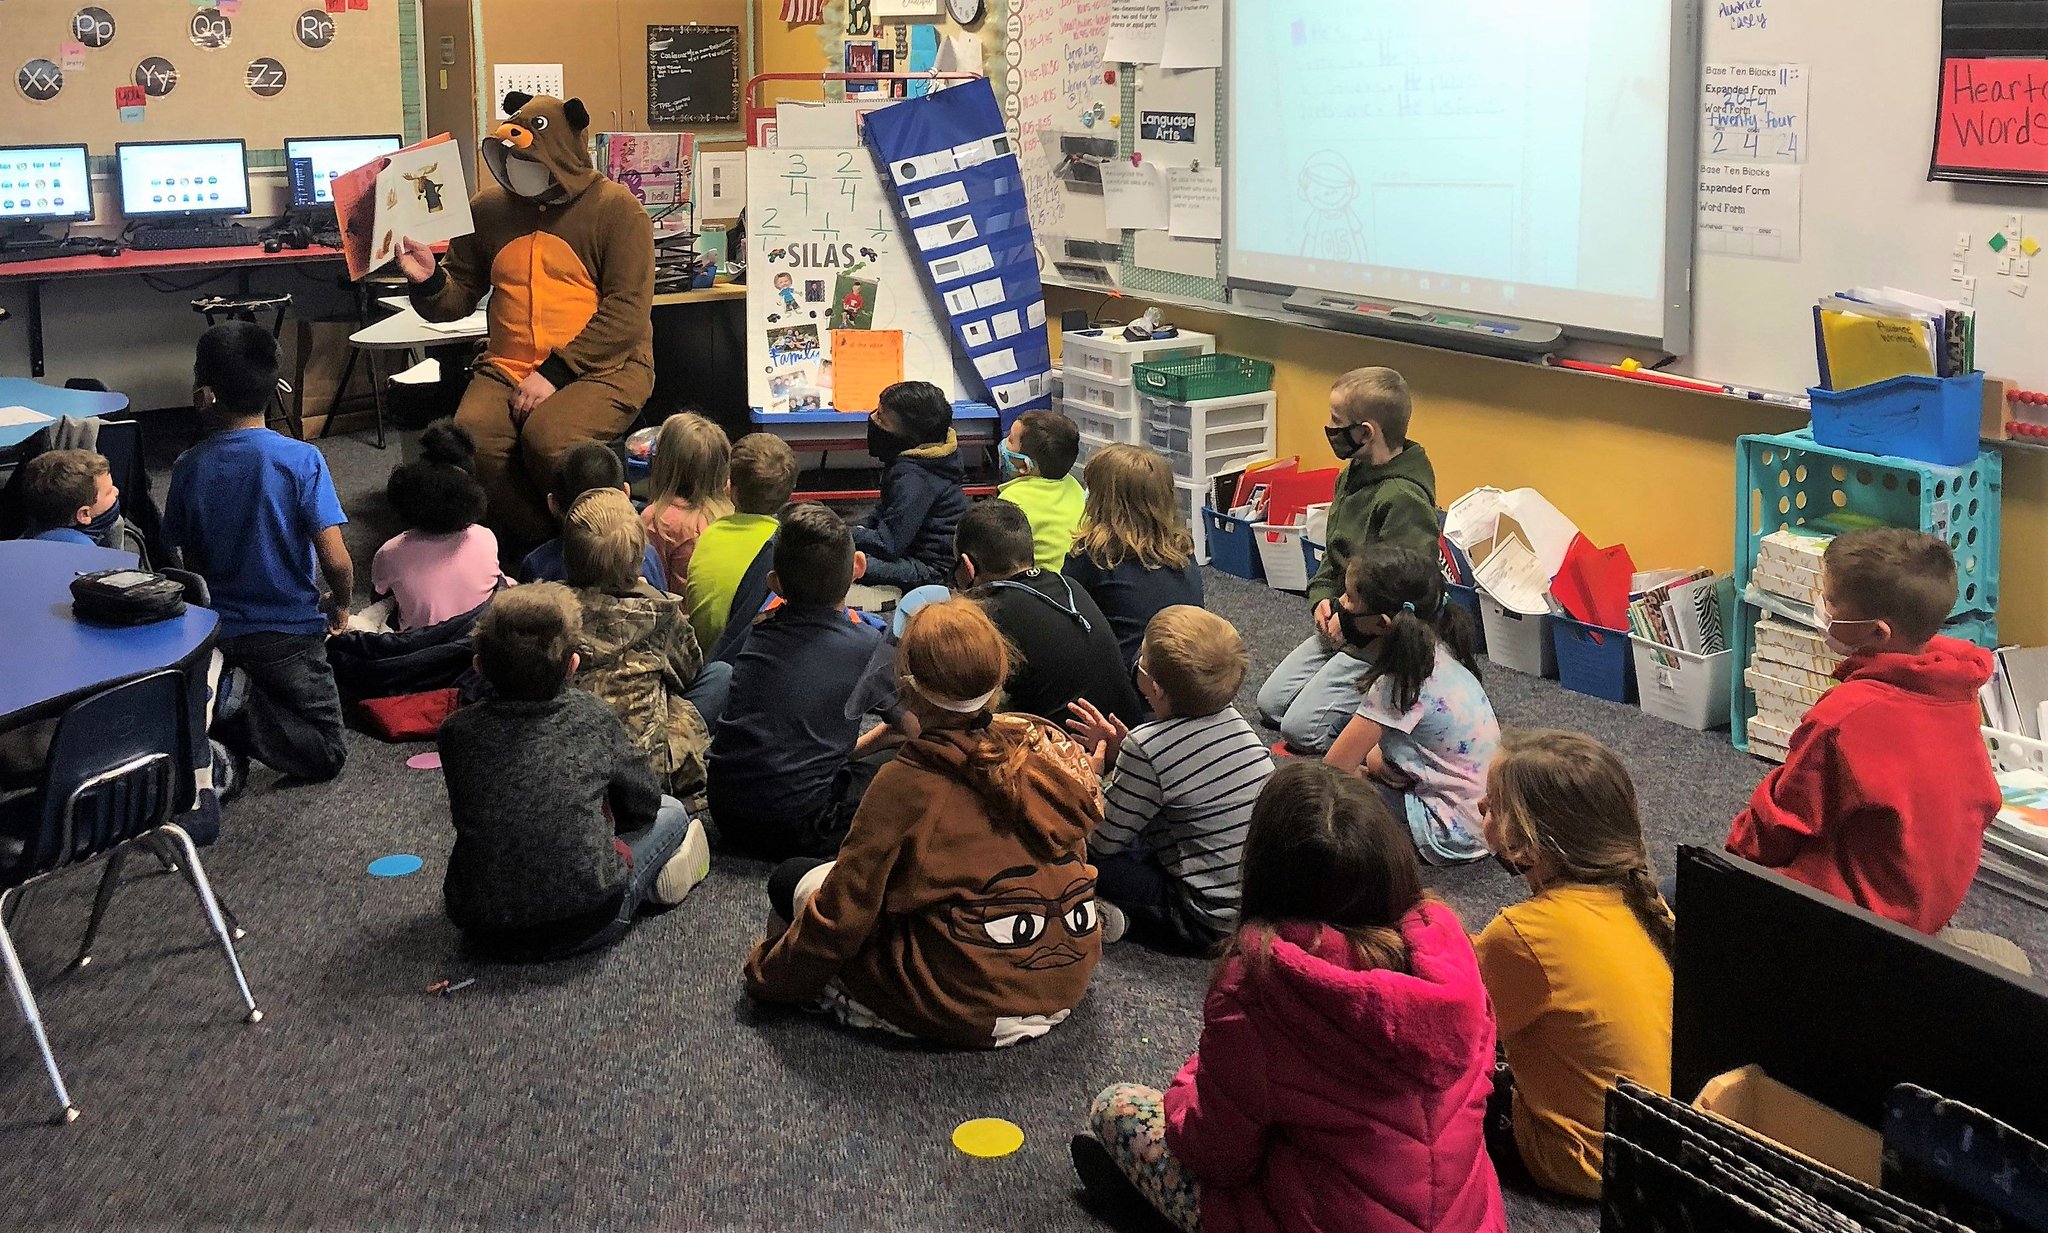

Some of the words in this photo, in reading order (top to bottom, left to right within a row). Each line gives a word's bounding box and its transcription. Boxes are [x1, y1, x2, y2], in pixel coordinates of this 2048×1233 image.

[75, 14, 113, 45] Pp
[193, 15, 229, 41] Qq
[300, 16, 332, 40] Rr
[23, 67, 60, 91] Xx
[139, 65, 170, 93] Yy
[251, 64, 284, 88] Zz
[1705, 66, 1727, 75] Base
[1730, 66, 1747, 76] Ten
[1749, 67, 1777, 77] Blocks
[1705, 84, 1749, 95] Expanded
[1751, 86, 1777, 95] Form
[1705, 103, 1727, 113] Word
[1729, 104, 1751, 115] Form
[1141, 112, 1195, 129] Language
[1155, 127, 1180, 140] Arts
[1712, 132, 1728, 154] 2
[1743, 134, 1758, 158] 4
[788, 154, 808, 175] 3
[837, 152, 862, 173] 2
[1700, 165, 1720, 174] Base
[1724, 166, 1740, 174] Ten
[1742, 167, 1770, 177] Blocks
[651, 191, 669, 201] hello
[790, 179, 808, 217] 4
[841, 179, 856, 212] 4
[1700, 183, 1742, 193] Expanded
[1745, 185, 1770, 195] Form
[761, 207, 781, 228] 2
[1699, 202, 1722, 212] Word
[1724, 203, 1745, 214] Form
[788, 243, 855, 268] SILAS
